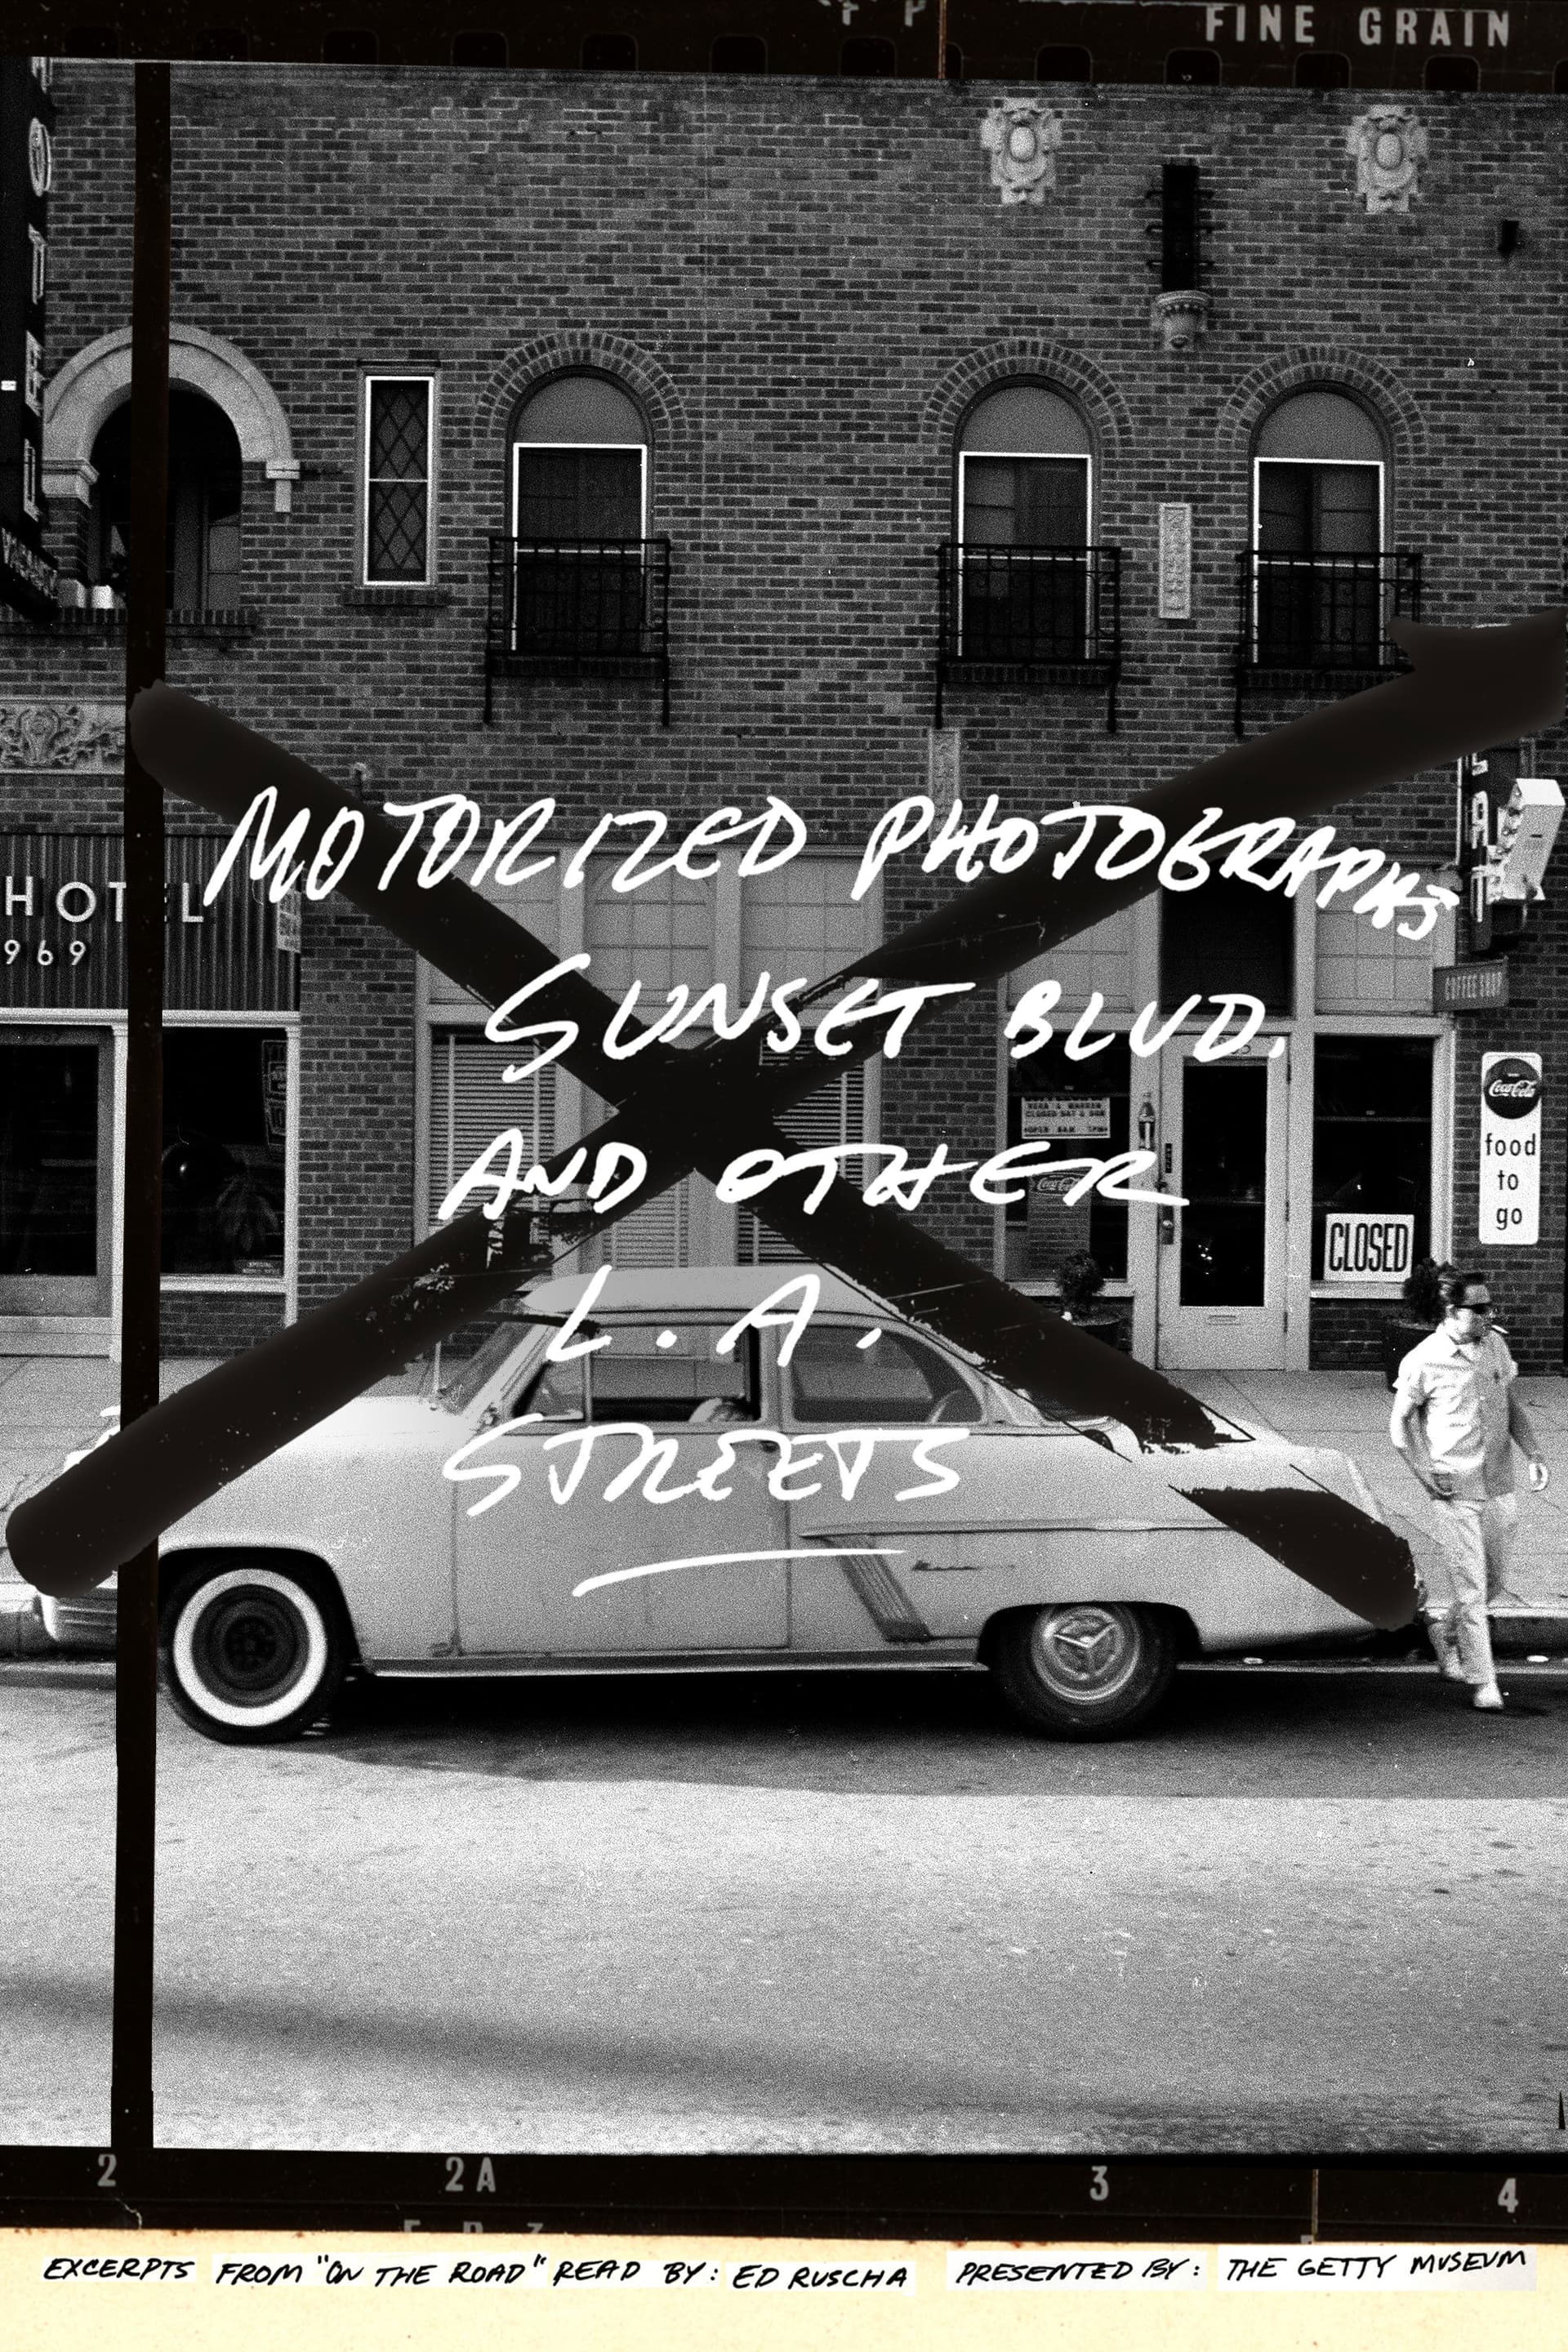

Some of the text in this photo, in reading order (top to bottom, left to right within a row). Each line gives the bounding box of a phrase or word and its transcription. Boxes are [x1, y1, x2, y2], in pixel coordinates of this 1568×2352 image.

[1205, 4, 1509, 47] FINE GRAIN
[4, 875, 204, 923] HOTL
[4, 939, 87, 966] 969
[1485, 1133, 1536, 1156] food
[1498, 1169, 1519, 1191] to
[1496, 1208, 1522, 1231] go
[1329, 1222, 1409, 1272] CLOSED
[97, 2154, 117, 2187] 2
[1089, 2165, 1109, 2201] 3
[1498, 2177, 1519, 2213] 4
